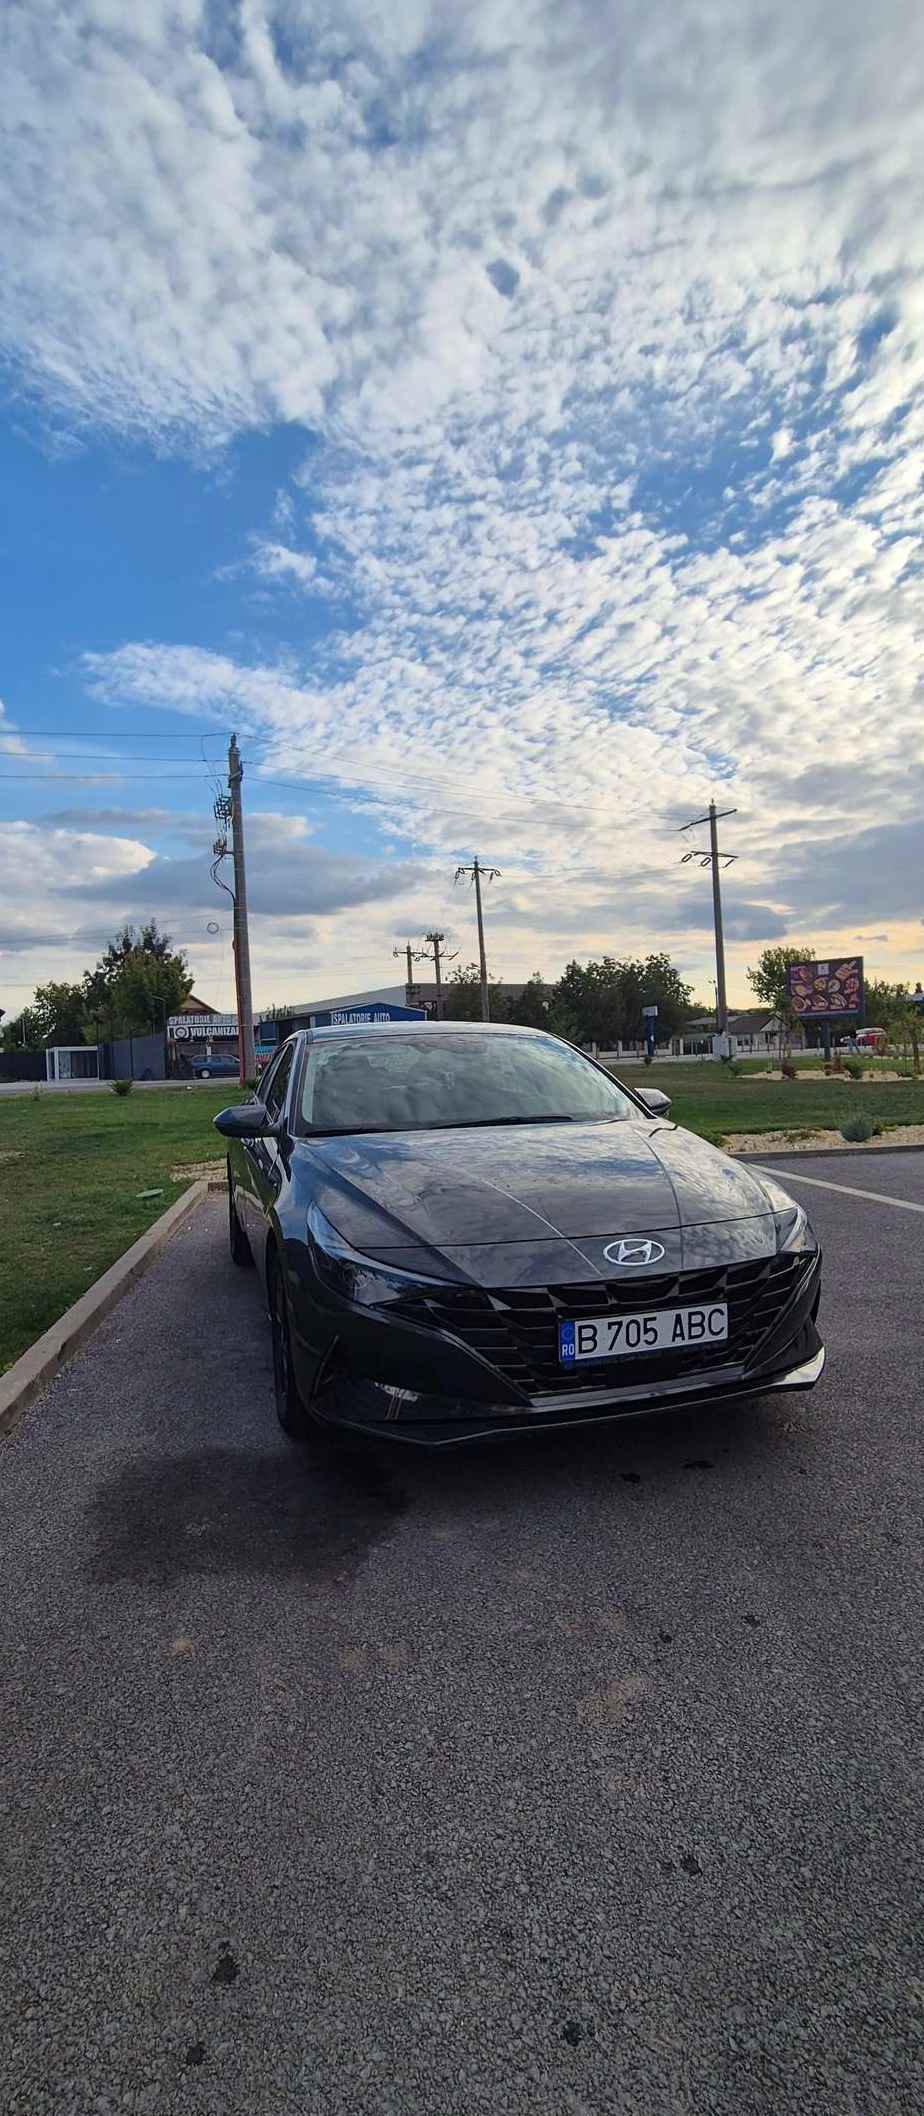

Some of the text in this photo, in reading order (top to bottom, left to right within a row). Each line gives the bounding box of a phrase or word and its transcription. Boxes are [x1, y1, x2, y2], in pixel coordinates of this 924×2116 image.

[333, 1011, 391, 1025] SPALATORIE AUTO
[577, 1308, 725, 1354] B 705 ABC
[561, 1343, 575, 1357] RO
